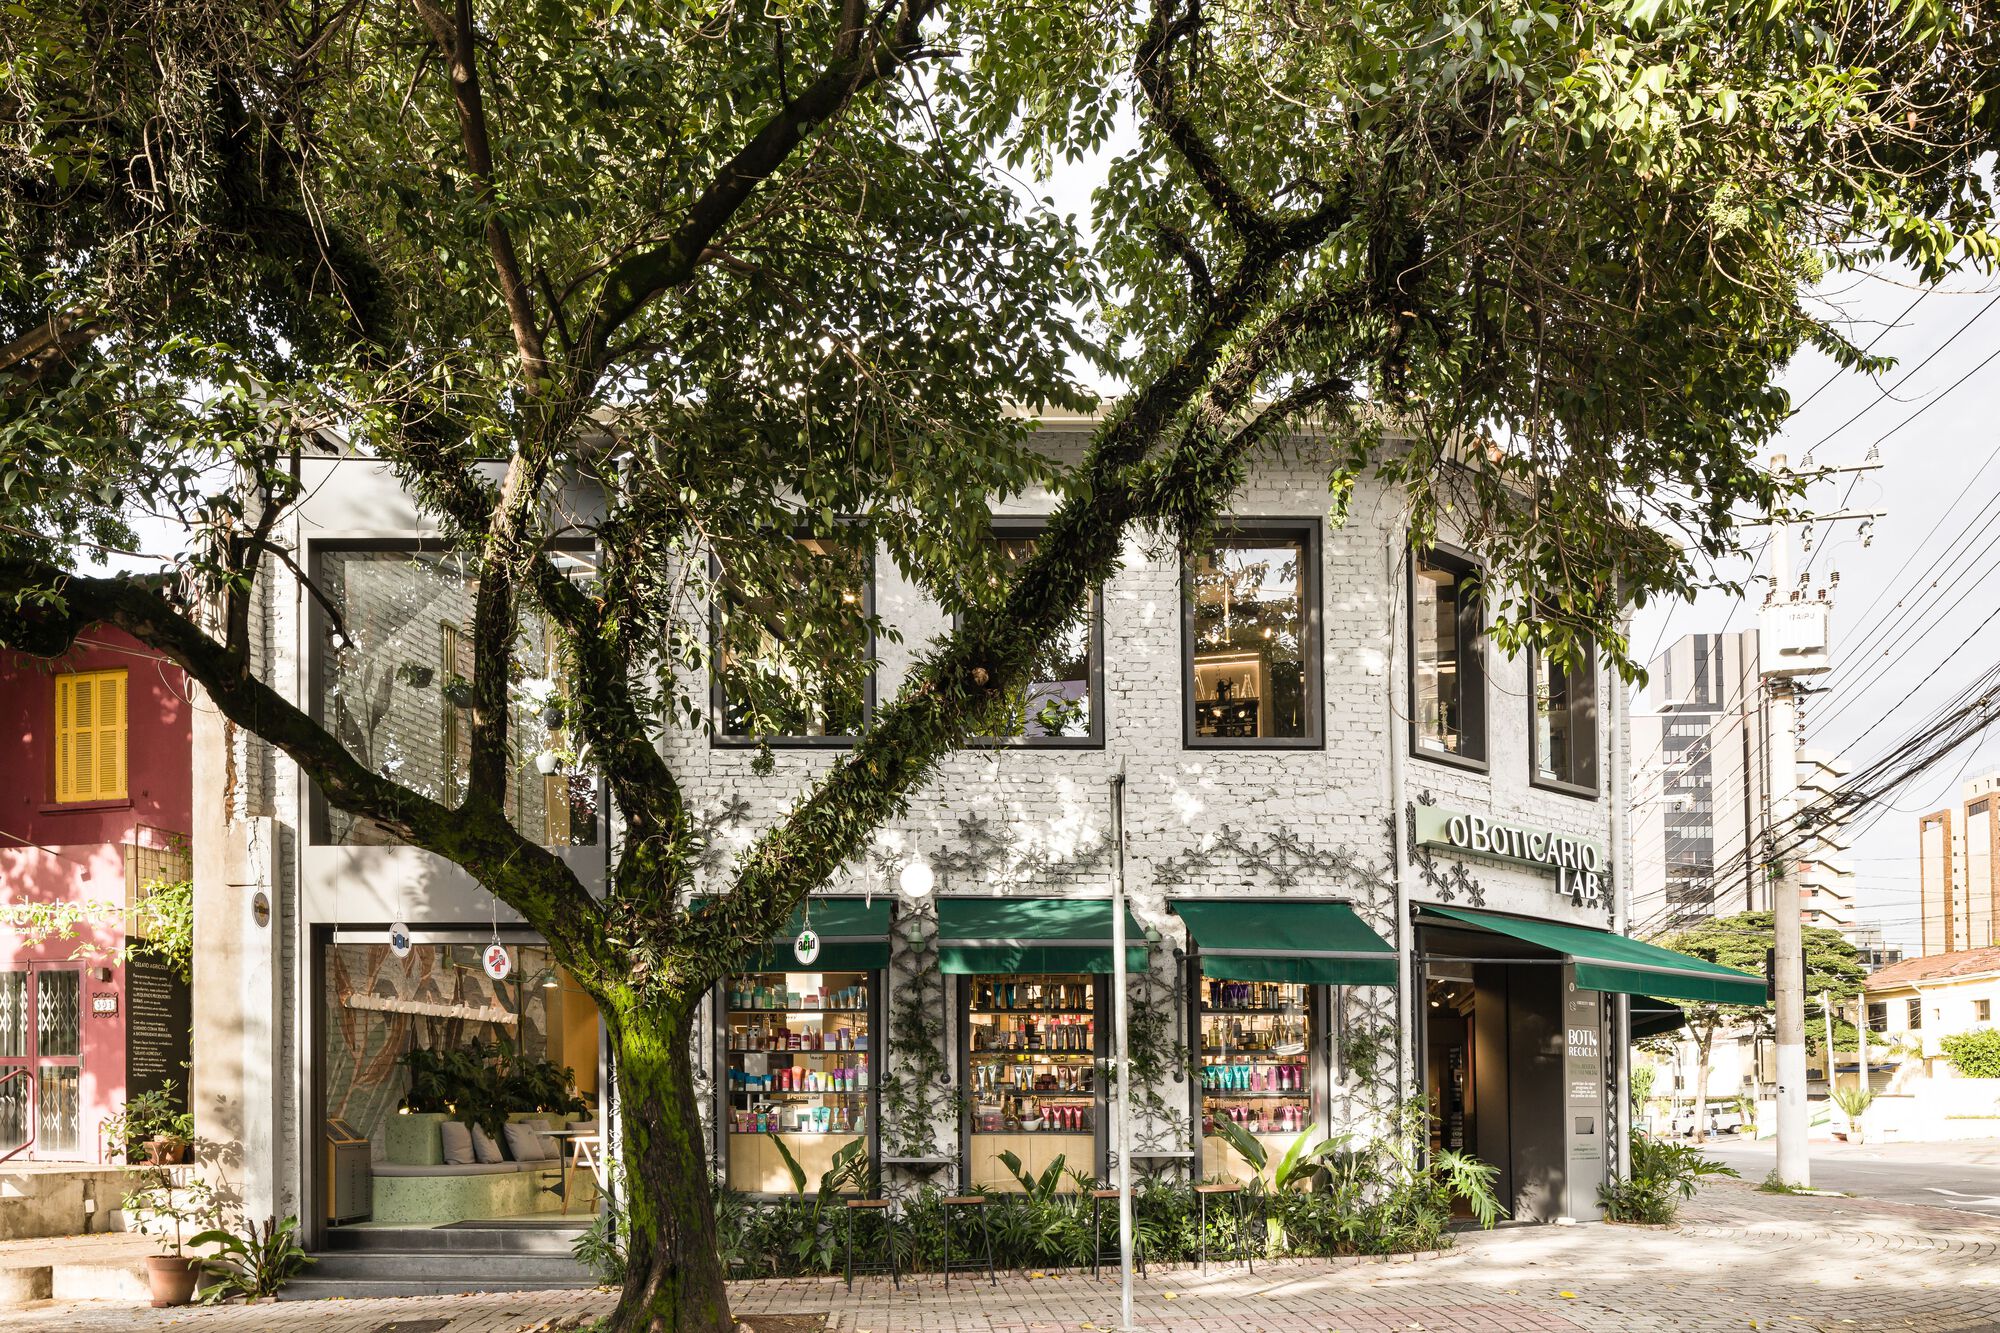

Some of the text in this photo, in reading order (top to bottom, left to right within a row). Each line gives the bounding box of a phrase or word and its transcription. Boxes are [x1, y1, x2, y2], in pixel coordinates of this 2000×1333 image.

[1557, 866, 1599, 900] LAB
[798, 938, 815, 950] acid
[1568, 1046, 1598, 1057] RECICLA
